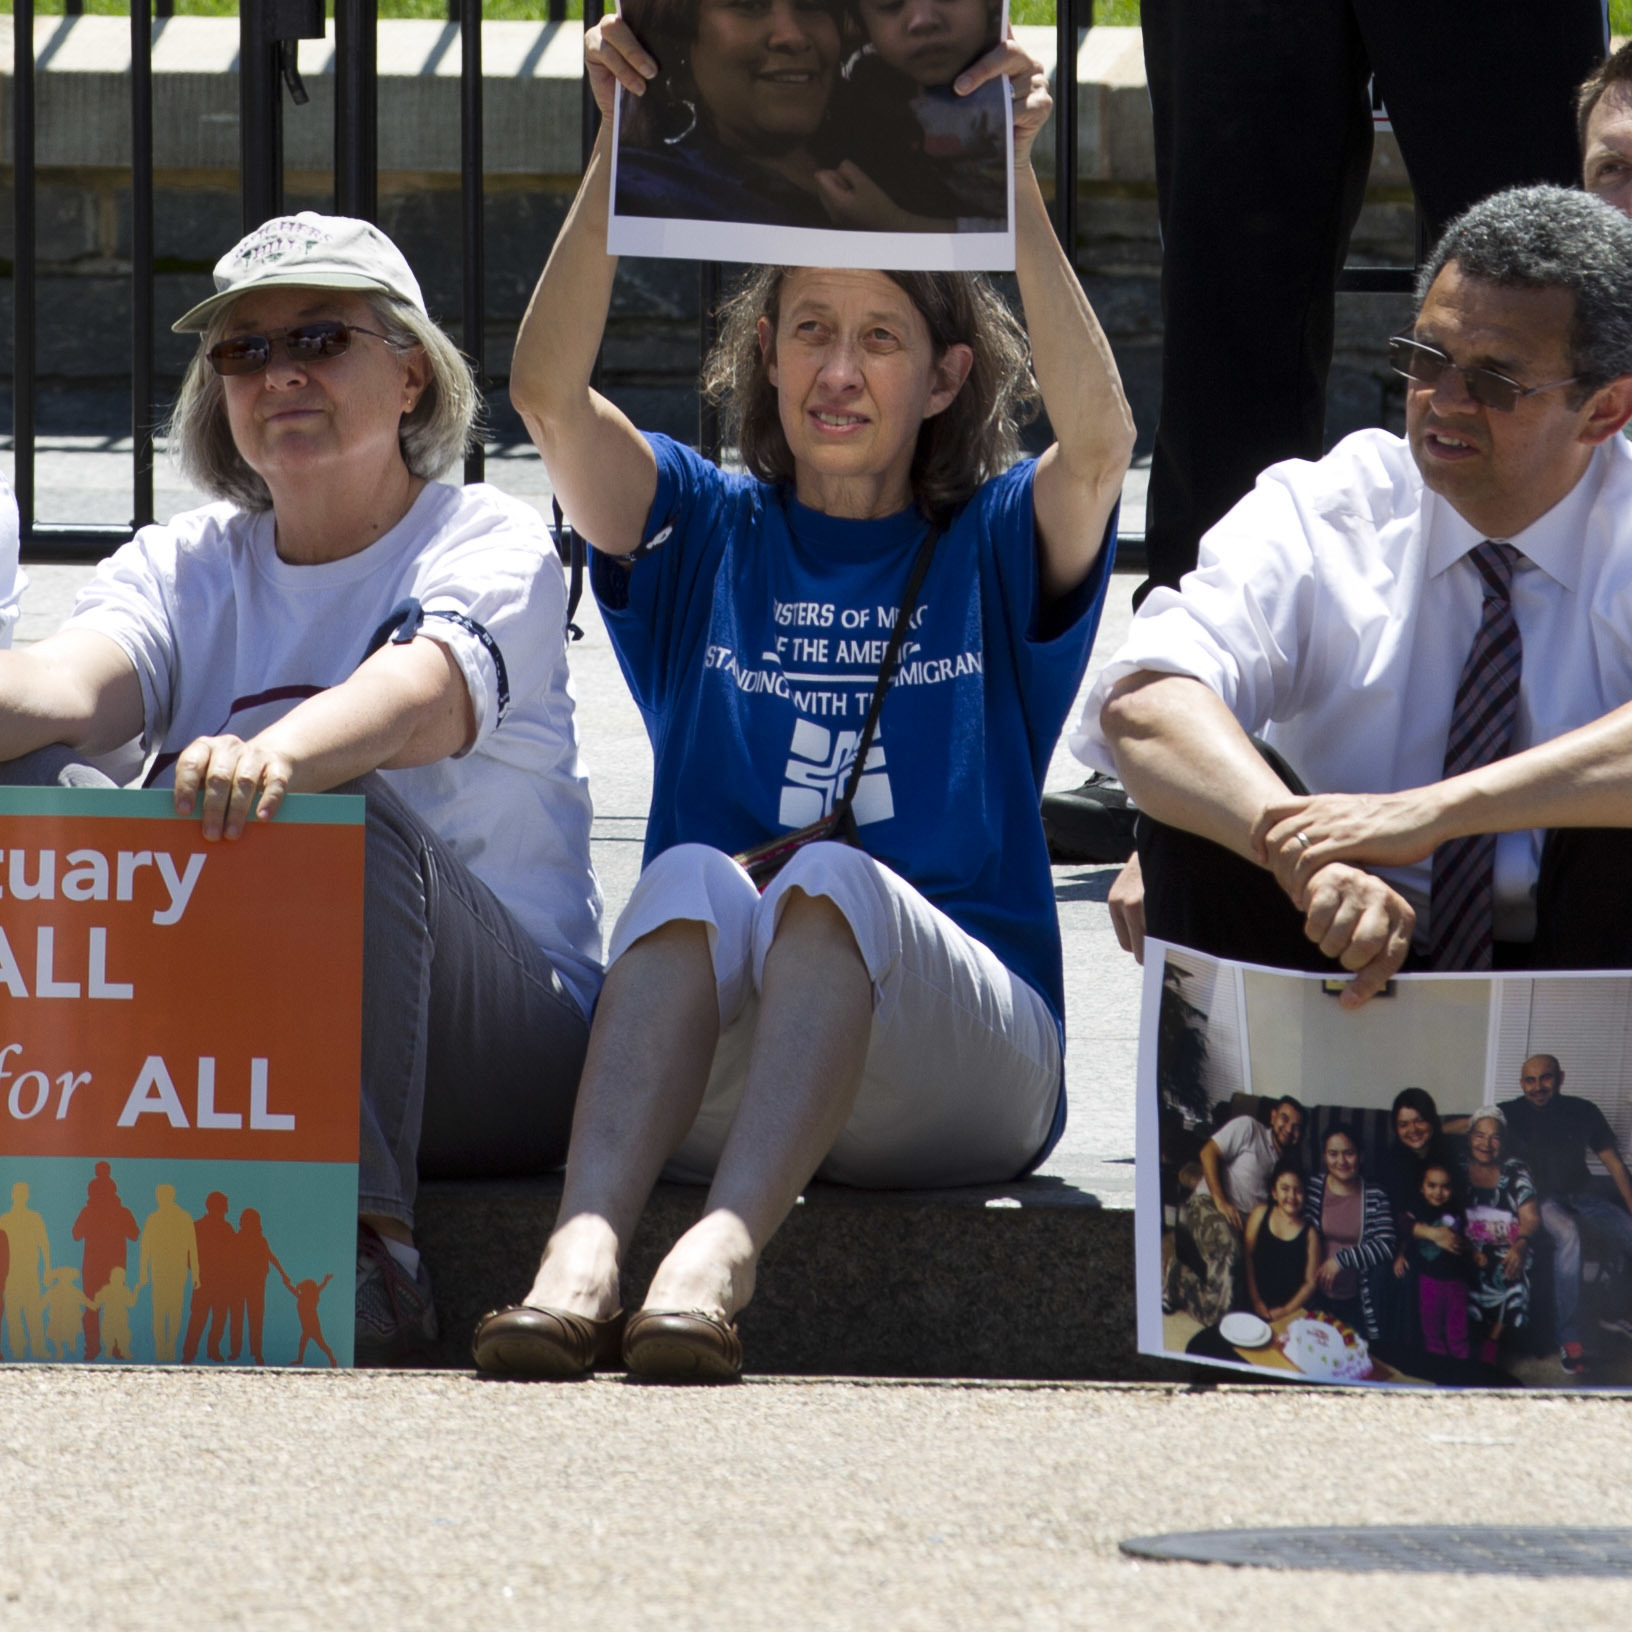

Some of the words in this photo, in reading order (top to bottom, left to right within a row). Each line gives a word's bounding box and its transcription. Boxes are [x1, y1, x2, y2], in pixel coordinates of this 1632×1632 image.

[773, 597, 835, 627] ISTERS
[841, 608, 870, 629] OF
[792, 638, 829, 663] THE
[705, 645, 790, 699] STANDING
[791, 689, 847, 716] WITH
[116, 1055, 296, 1131] ALL
